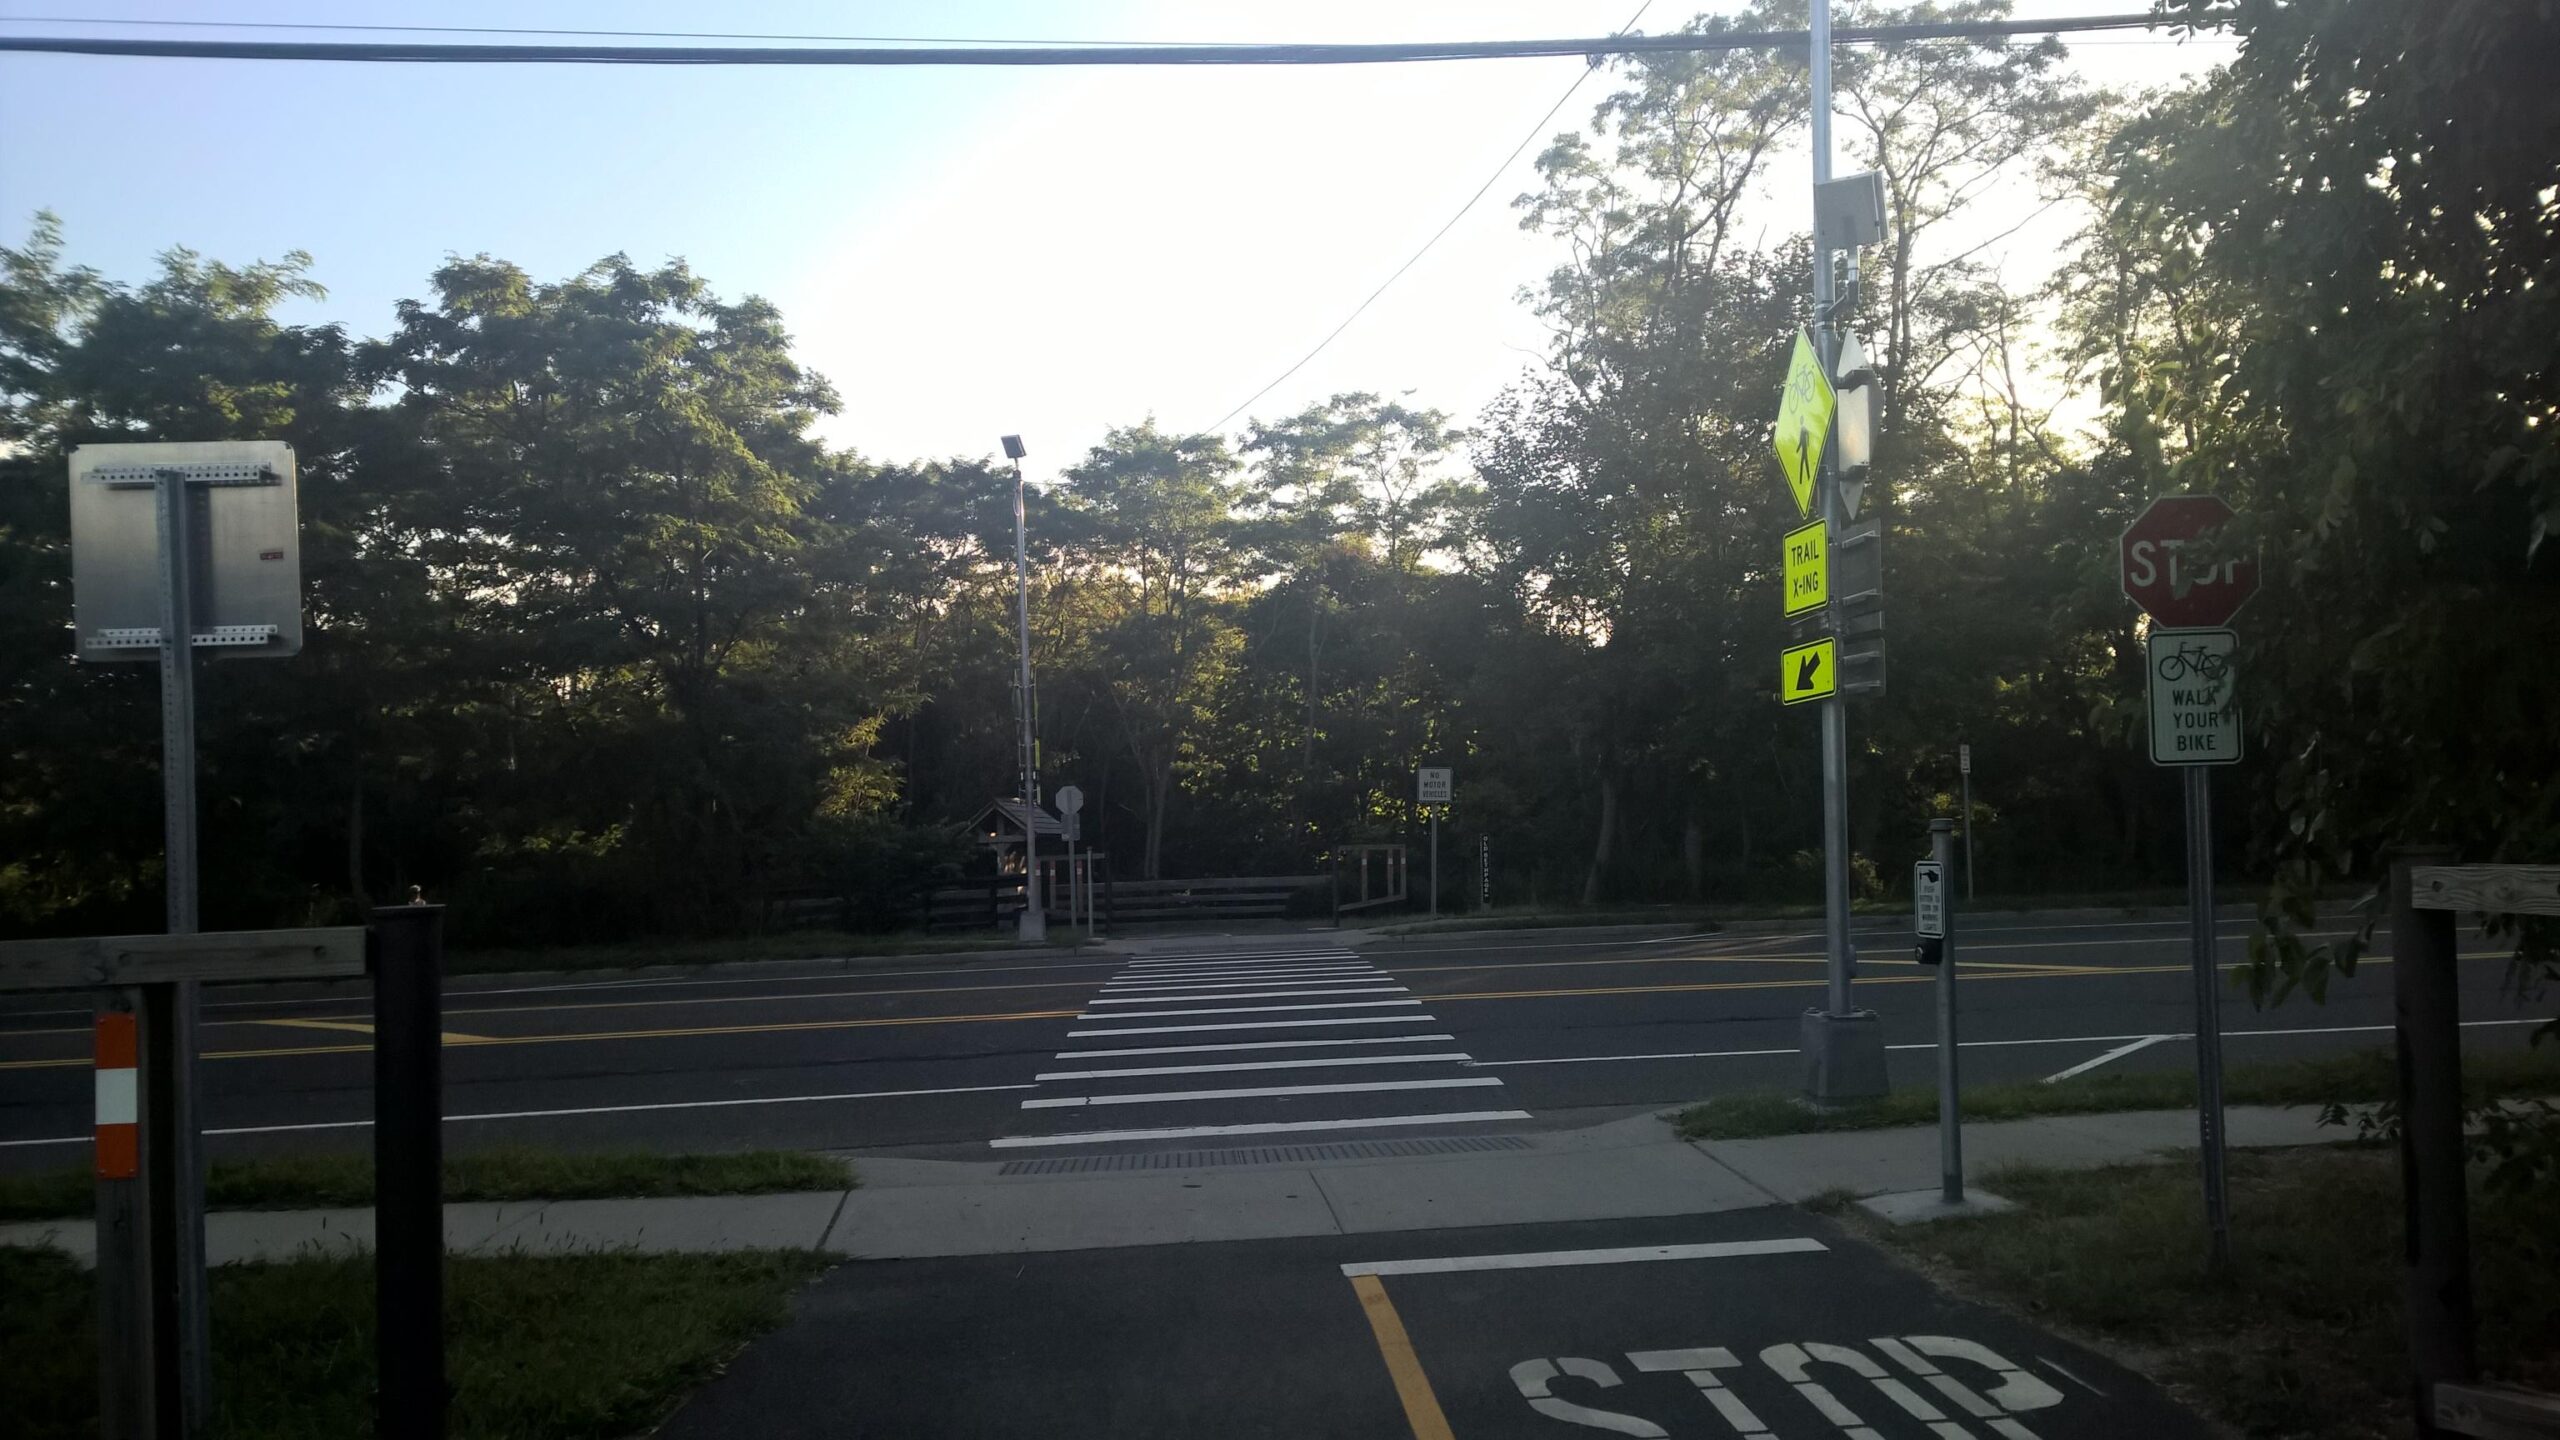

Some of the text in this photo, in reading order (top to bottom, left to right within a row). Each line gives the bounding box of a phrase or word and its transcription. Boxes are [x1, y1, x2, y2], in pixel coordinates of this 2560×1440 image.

[1791, 540, 1819, 567] TRAIL
[1793, 571, 1819, 598] X-ING
[2172, 689, 2217, 706] WALK
[2173, 712, 2218, 729] YOUR
[2176, 734, 2217, 751] BIKE
[1430, 771, 1440, 779] NO
[1423, 781, 1446, 789] MOTOR
